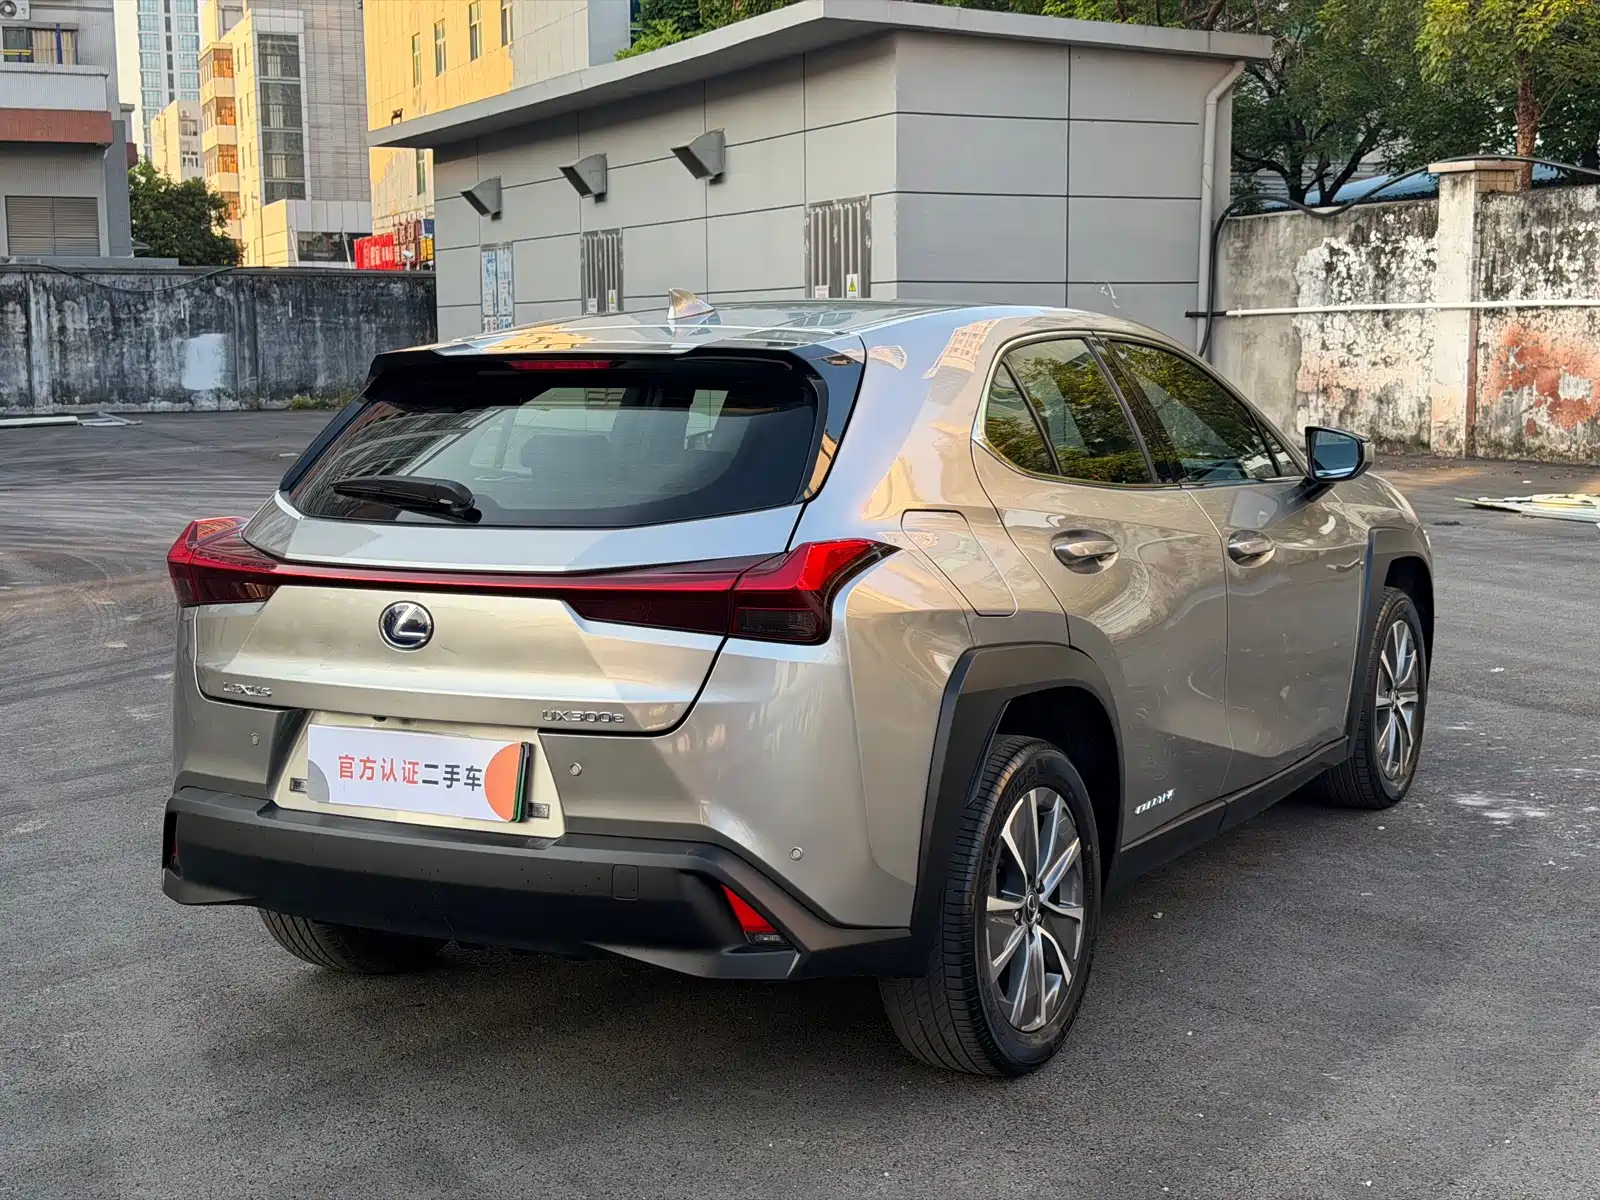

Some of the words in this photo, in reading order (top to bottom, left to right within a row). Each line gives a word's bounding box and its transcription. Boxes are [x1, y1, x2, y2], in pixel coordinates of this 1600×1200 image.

[542, 709, 625, 723] UX300e
[338, 754, 482, 791] 官方认证二手车
